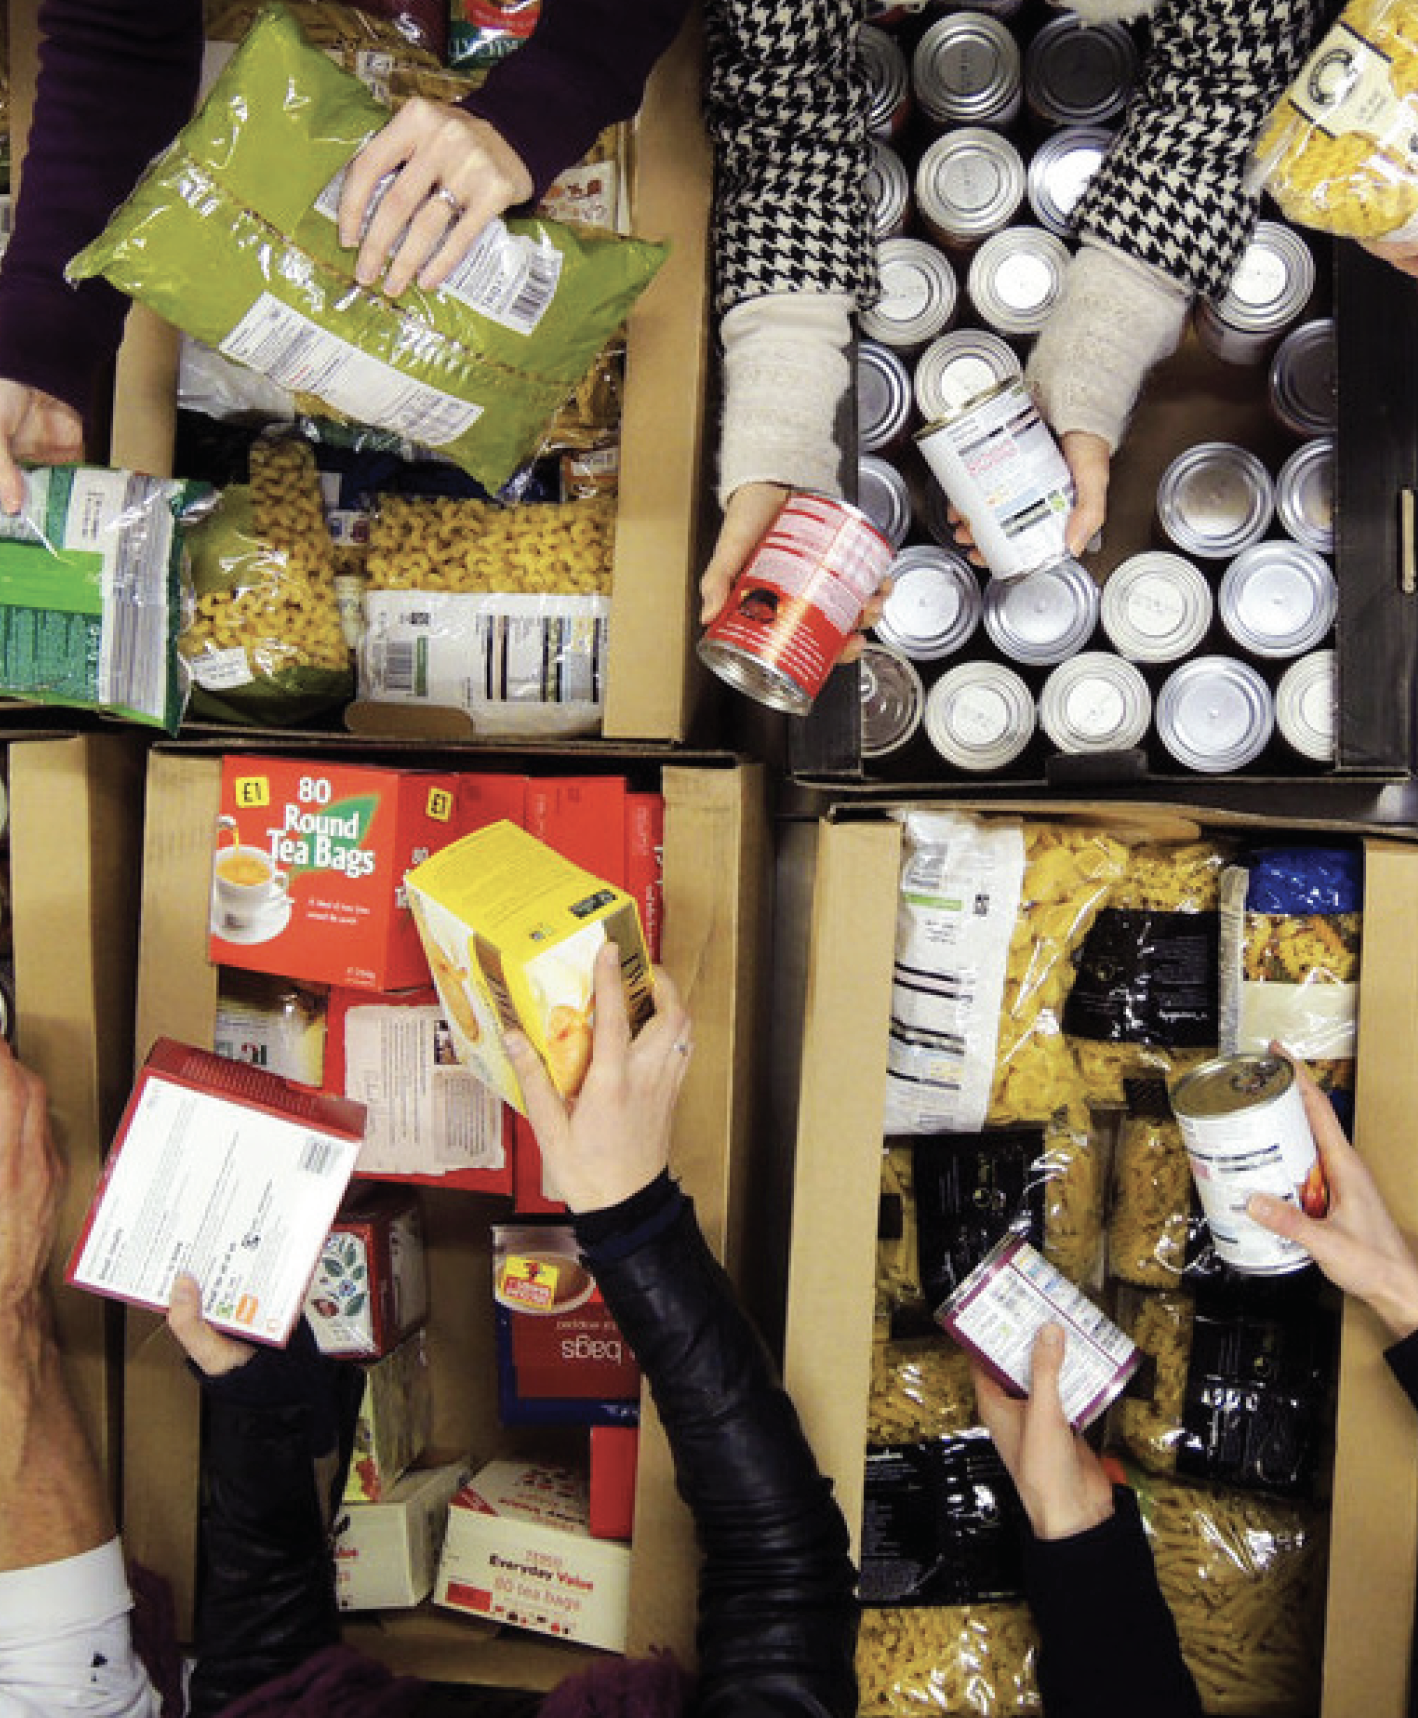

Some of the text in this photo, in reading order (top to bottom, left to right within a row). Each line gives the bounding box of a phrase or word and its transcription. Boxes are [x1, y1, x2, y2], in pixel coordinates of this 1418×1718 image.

[299, 776, 332, 804] 80
[284, 803, 360, 840] Round
[266, 828, 376, 878] Tea Bags
[561, 1334, 622, 1367] bags
[489, 1553, 594, 1592] Everyday Value
[545, 1589, 582, 1612] bags
